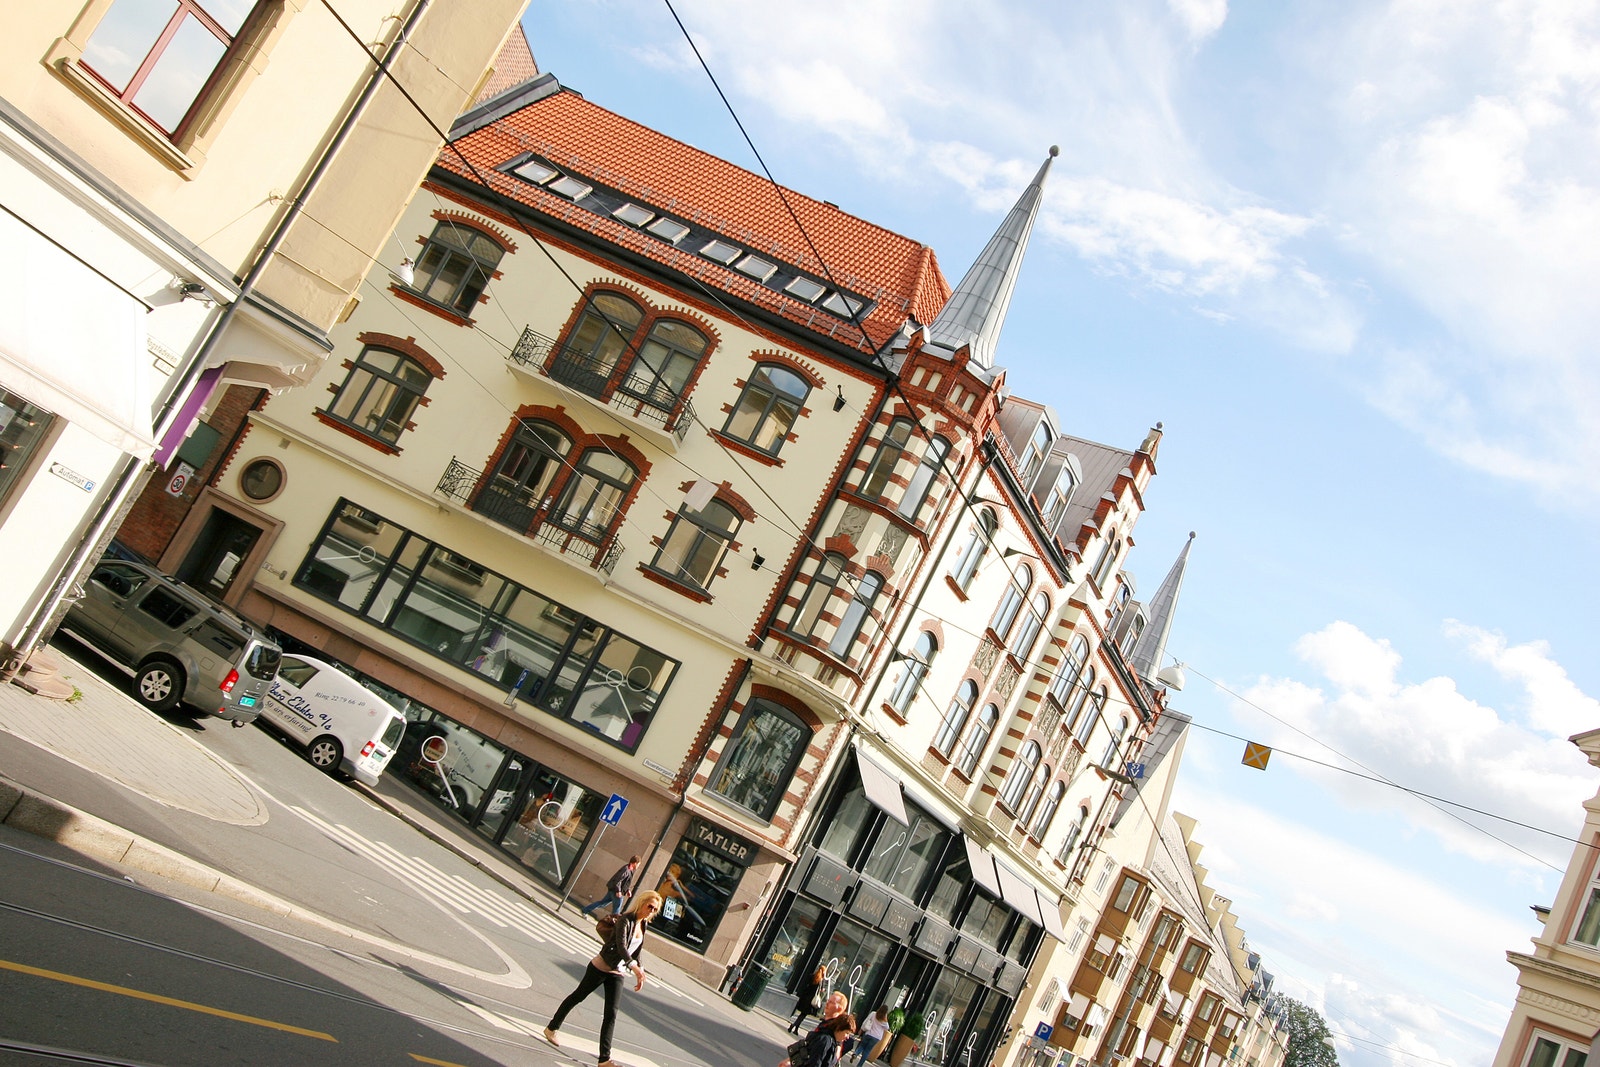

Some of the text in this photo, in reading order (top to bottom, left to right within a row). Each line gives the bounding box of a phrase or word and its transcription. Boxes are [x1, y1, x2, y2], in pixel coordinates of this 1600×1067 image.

[58, 467, 85, 486] Automat
[698, 825, 749, 860] TATLER
[1039, 1024, 1049, 1036] P
